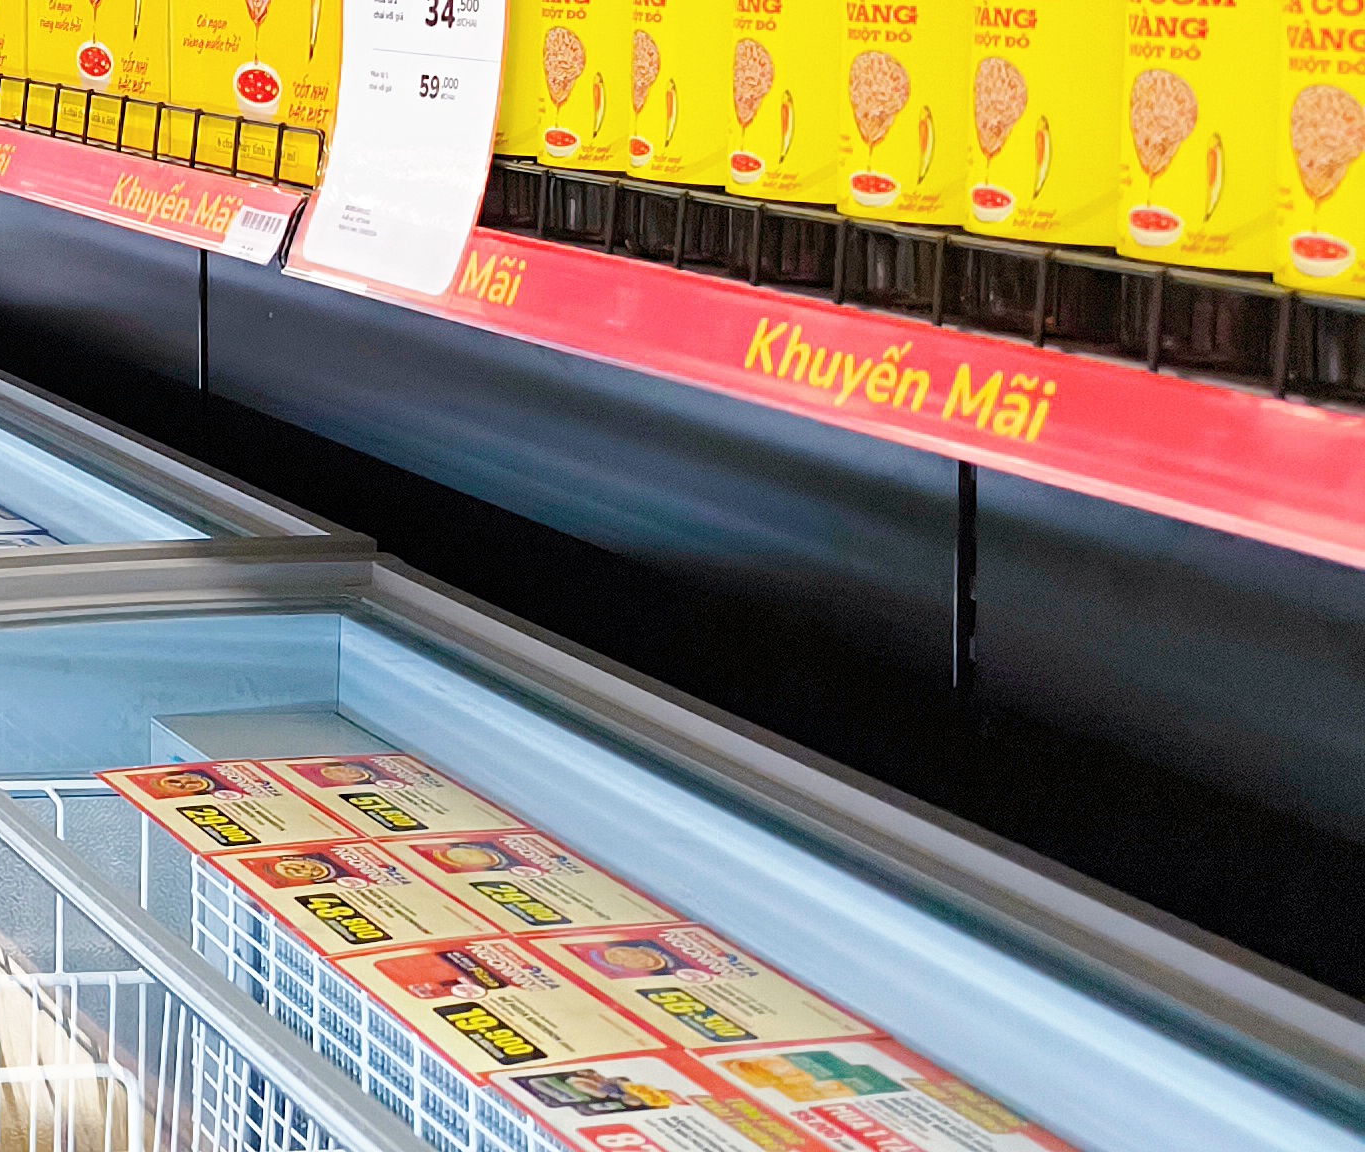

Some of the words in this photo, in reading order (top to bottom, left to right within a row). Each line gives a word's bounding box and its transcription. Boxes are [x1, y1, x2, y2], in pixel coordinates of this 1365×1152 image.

[884, 26, 913, 44] ĐỎ
[1004, 32, 1031, 49] ĐỎ
[1169, 44, 1202, 61] ĐỎ
[109, 169, 192, 227] Khuyến
[192, 194, 243, 235] Mãi
[457, 249, 527, 307] Mãi
[743, 316, 932, 413] Khuyến
[940, 362, 1058, 443] Mãi
[305, 896, 388, 941] 48.800
[444, 1006, 537, 1057] 19.900
